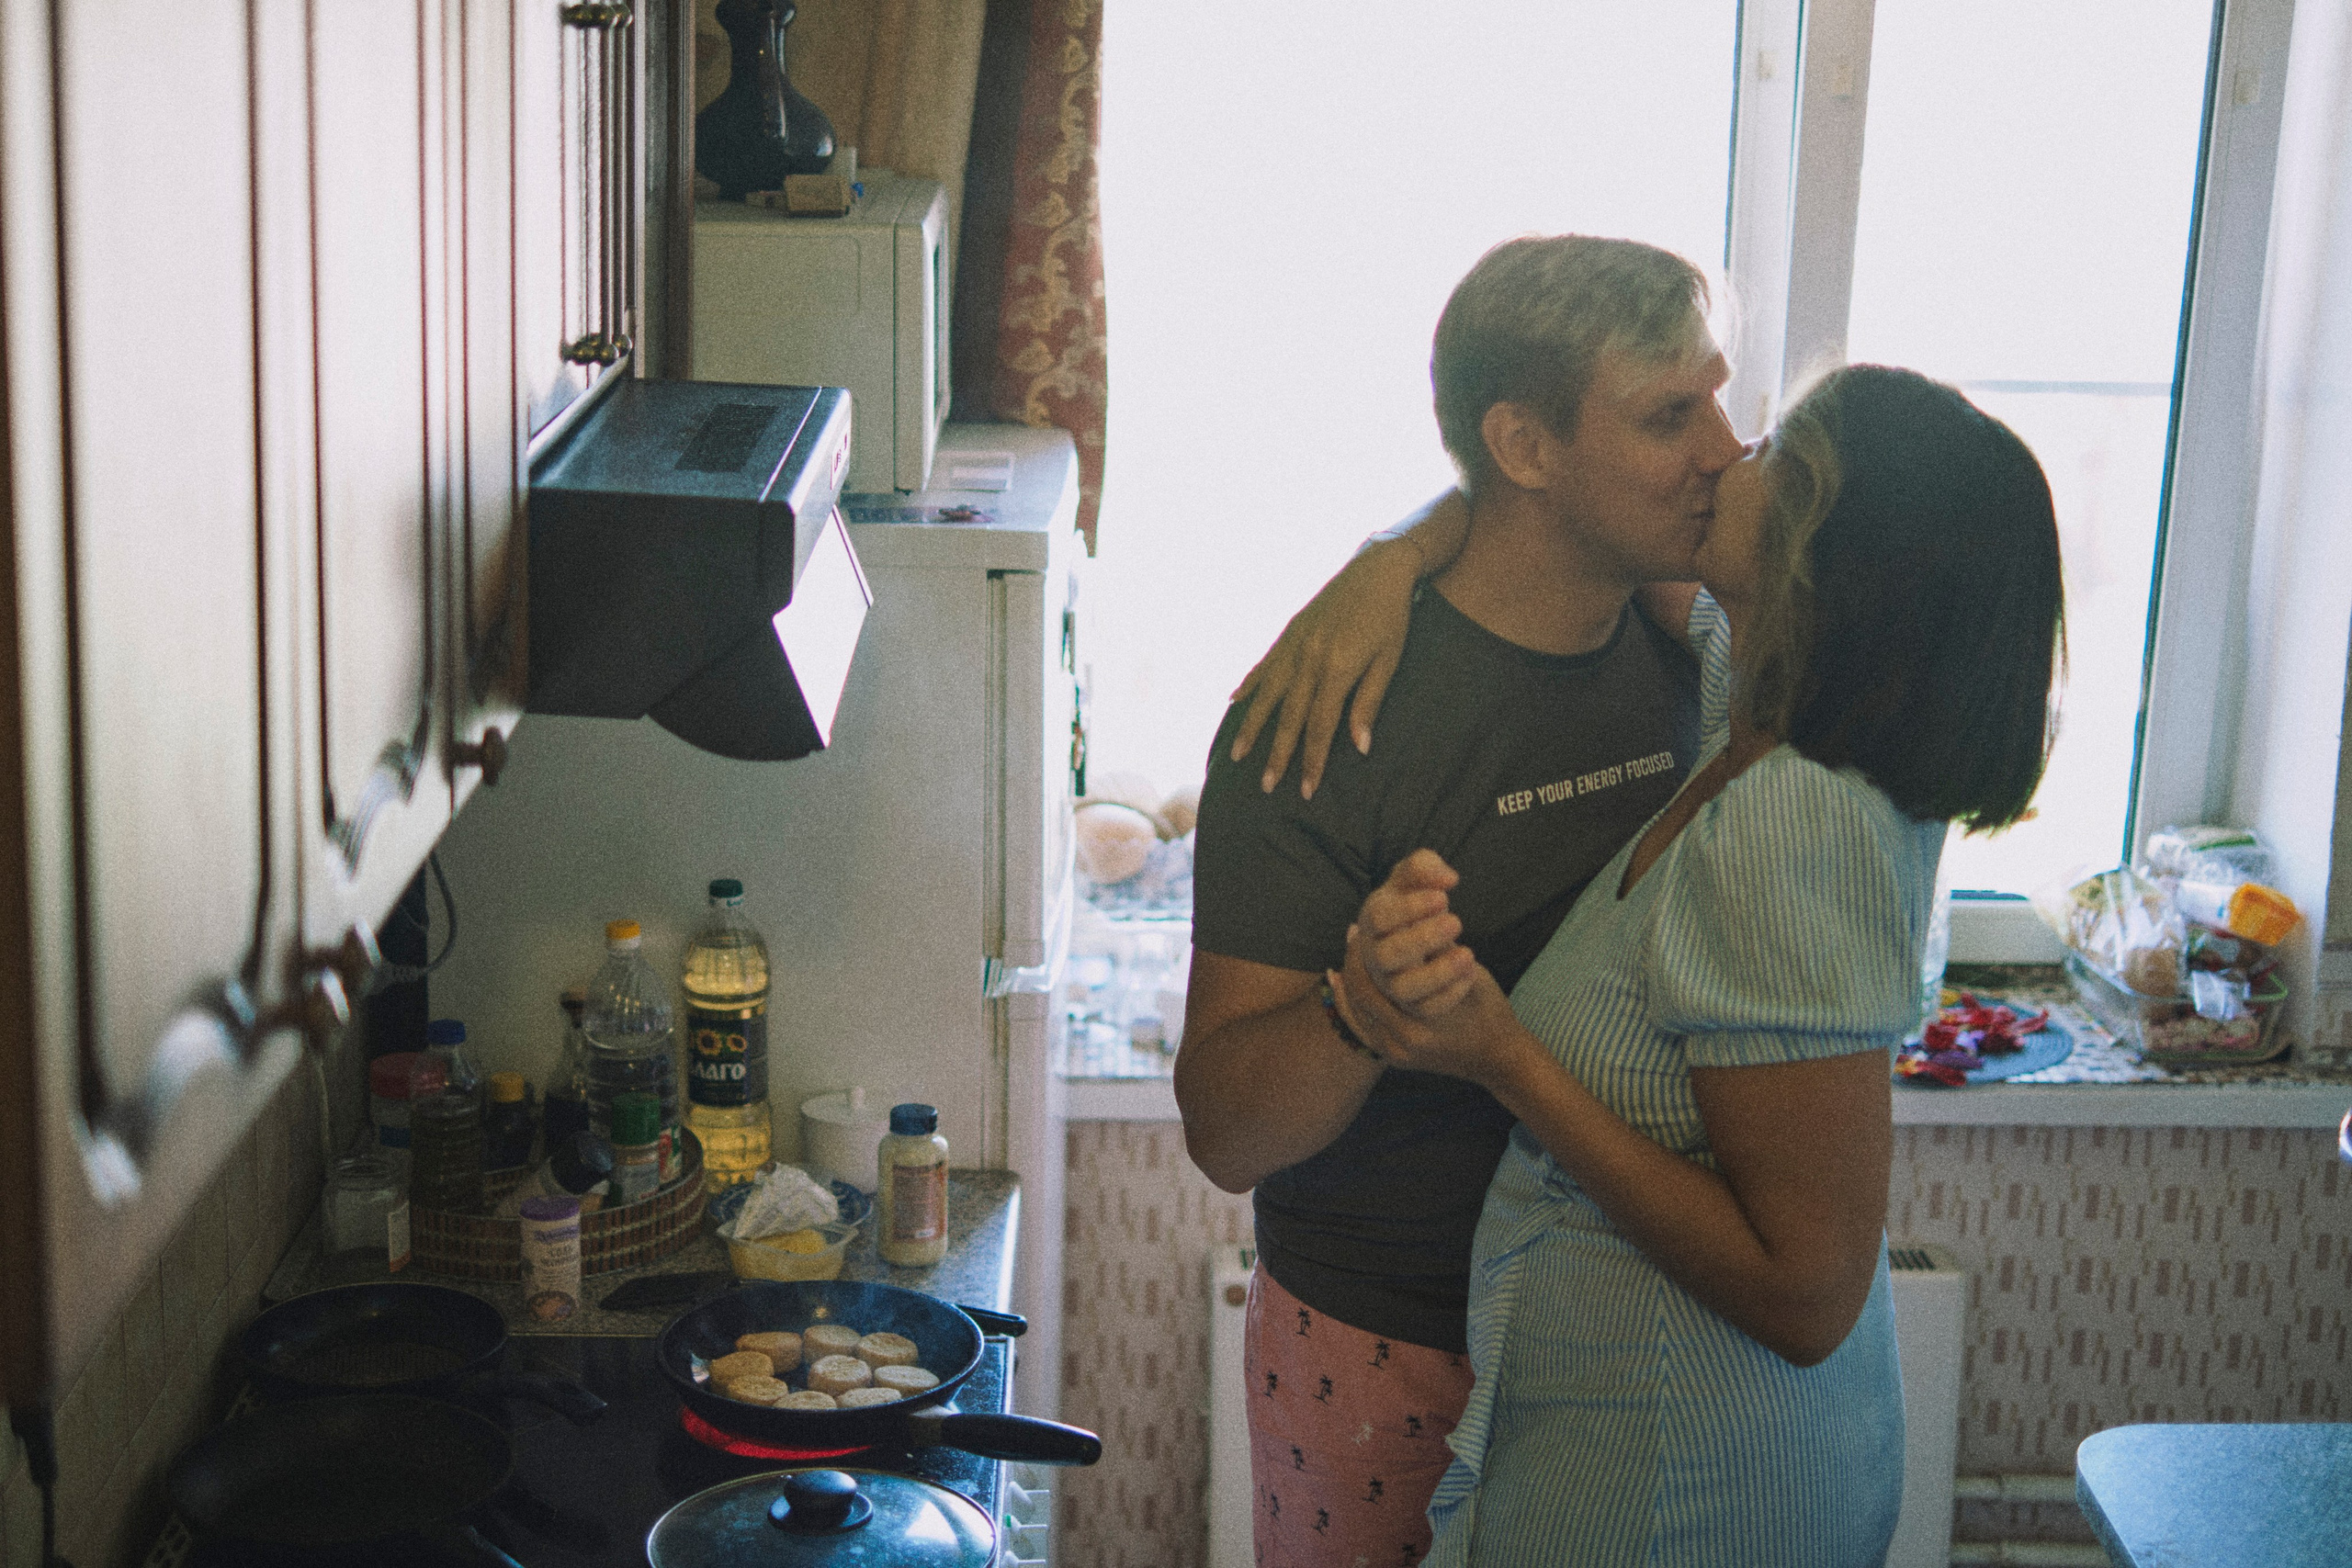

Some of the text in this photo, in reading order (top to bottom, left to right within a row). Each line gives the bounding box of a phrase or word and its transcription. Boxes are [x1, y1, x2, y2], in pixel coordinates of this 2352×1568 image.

[1498, 751, 1675, 816] KEEP YOUR ENERGY FOCUSED
